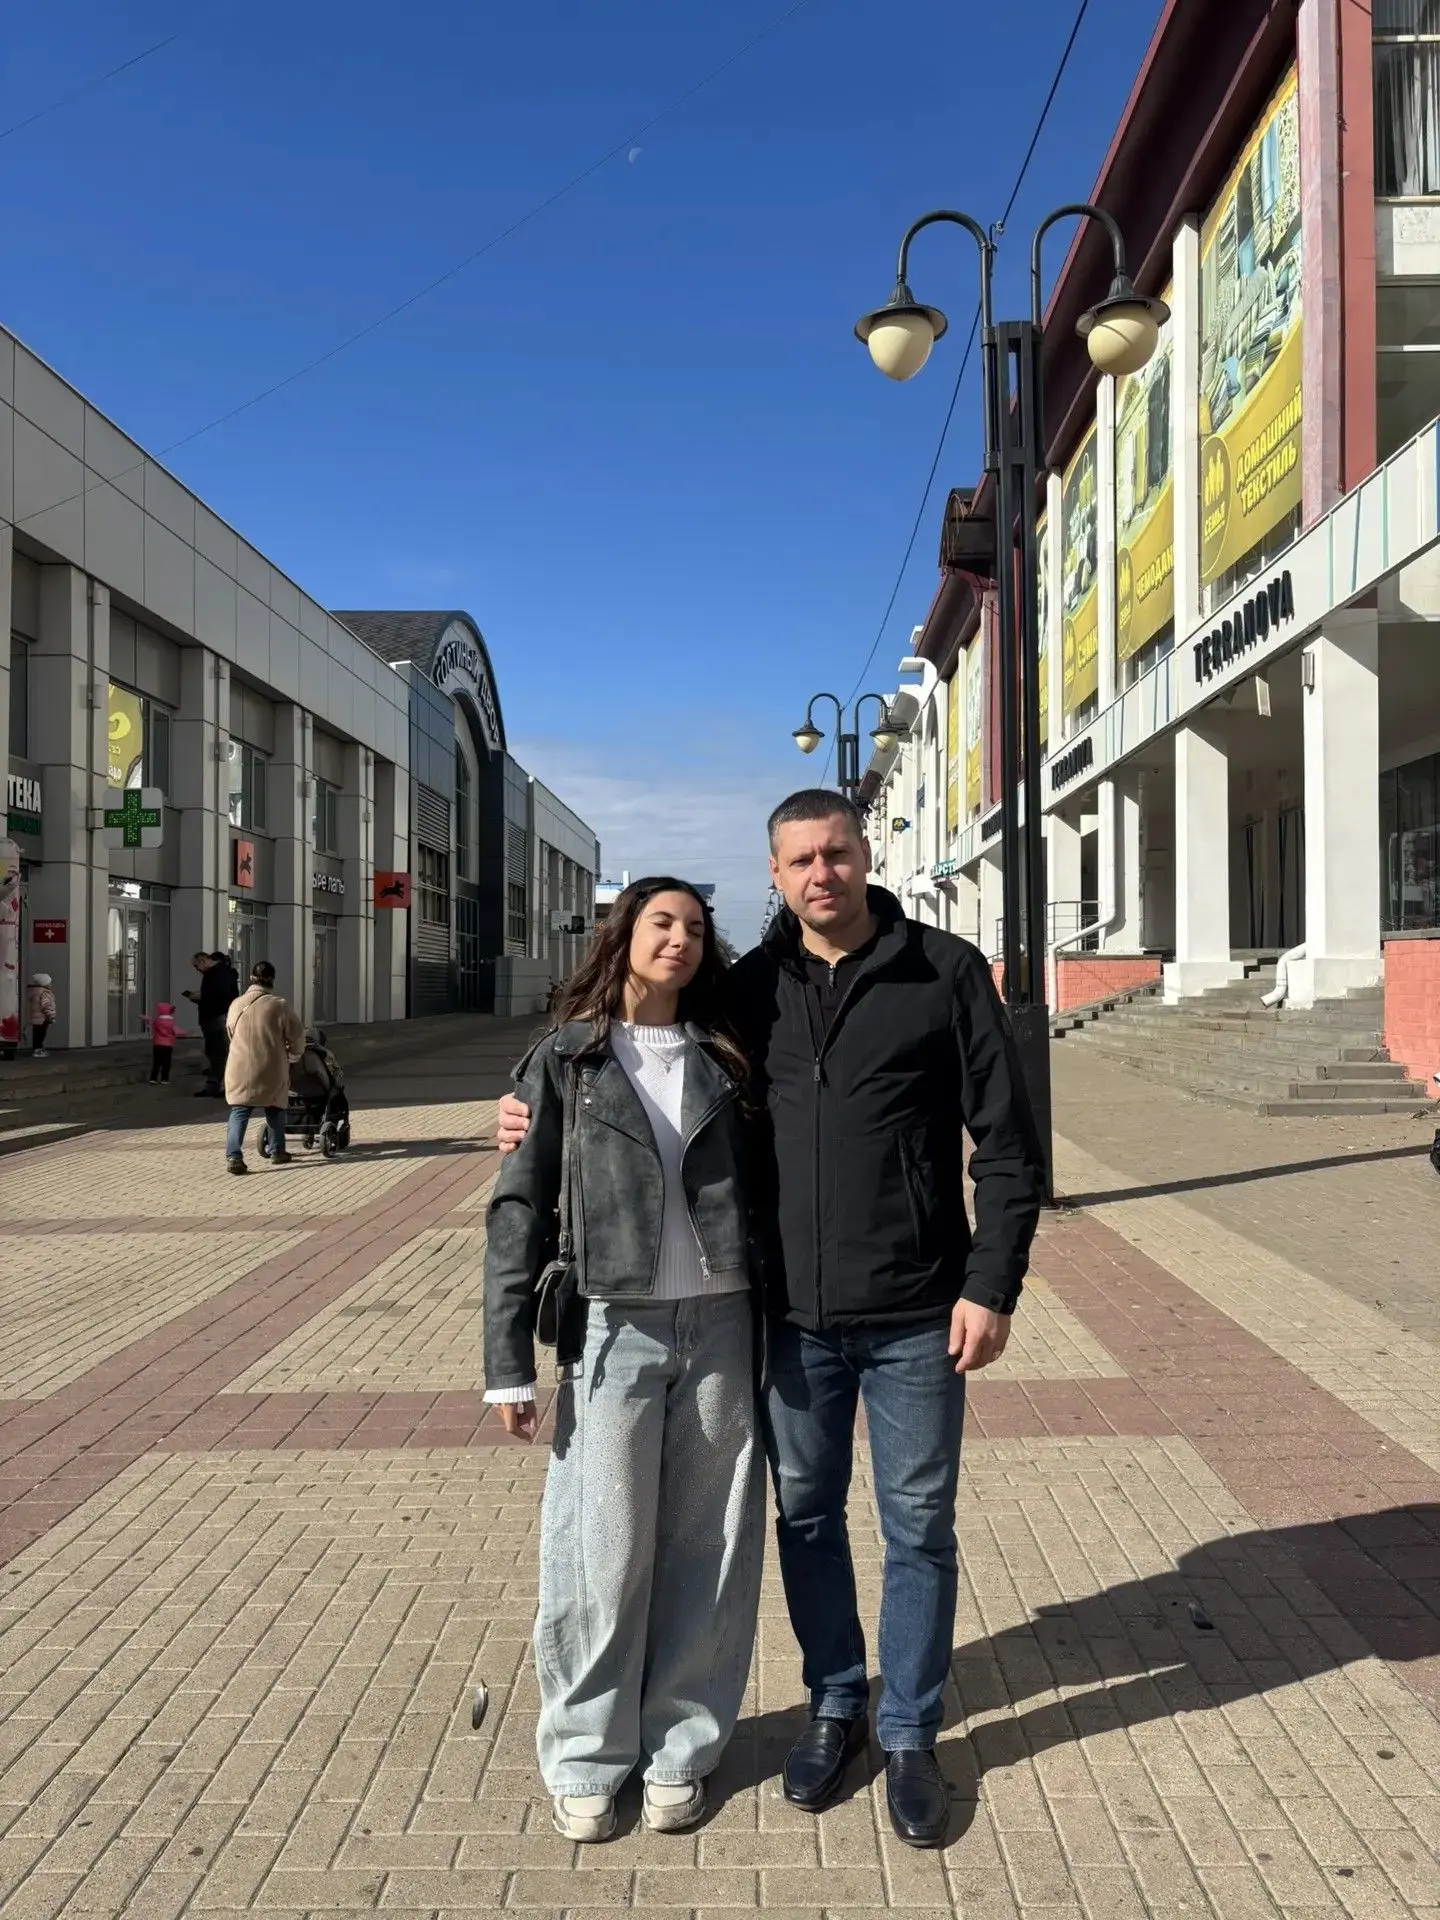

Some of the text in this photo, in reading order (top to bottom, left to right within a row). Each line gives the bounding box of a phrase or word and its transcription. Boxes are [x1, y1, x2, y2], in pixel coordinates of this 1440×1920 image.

[1237, 383, 1302, 491] ДОМАШНИЙ
[1241, 440, 1297, 517] ТЕКСТИЛЬ
[433, 640, 480, 688] ГОСТИНЫЙ
[1193, 570, 1294, 687] TERRANOVA
